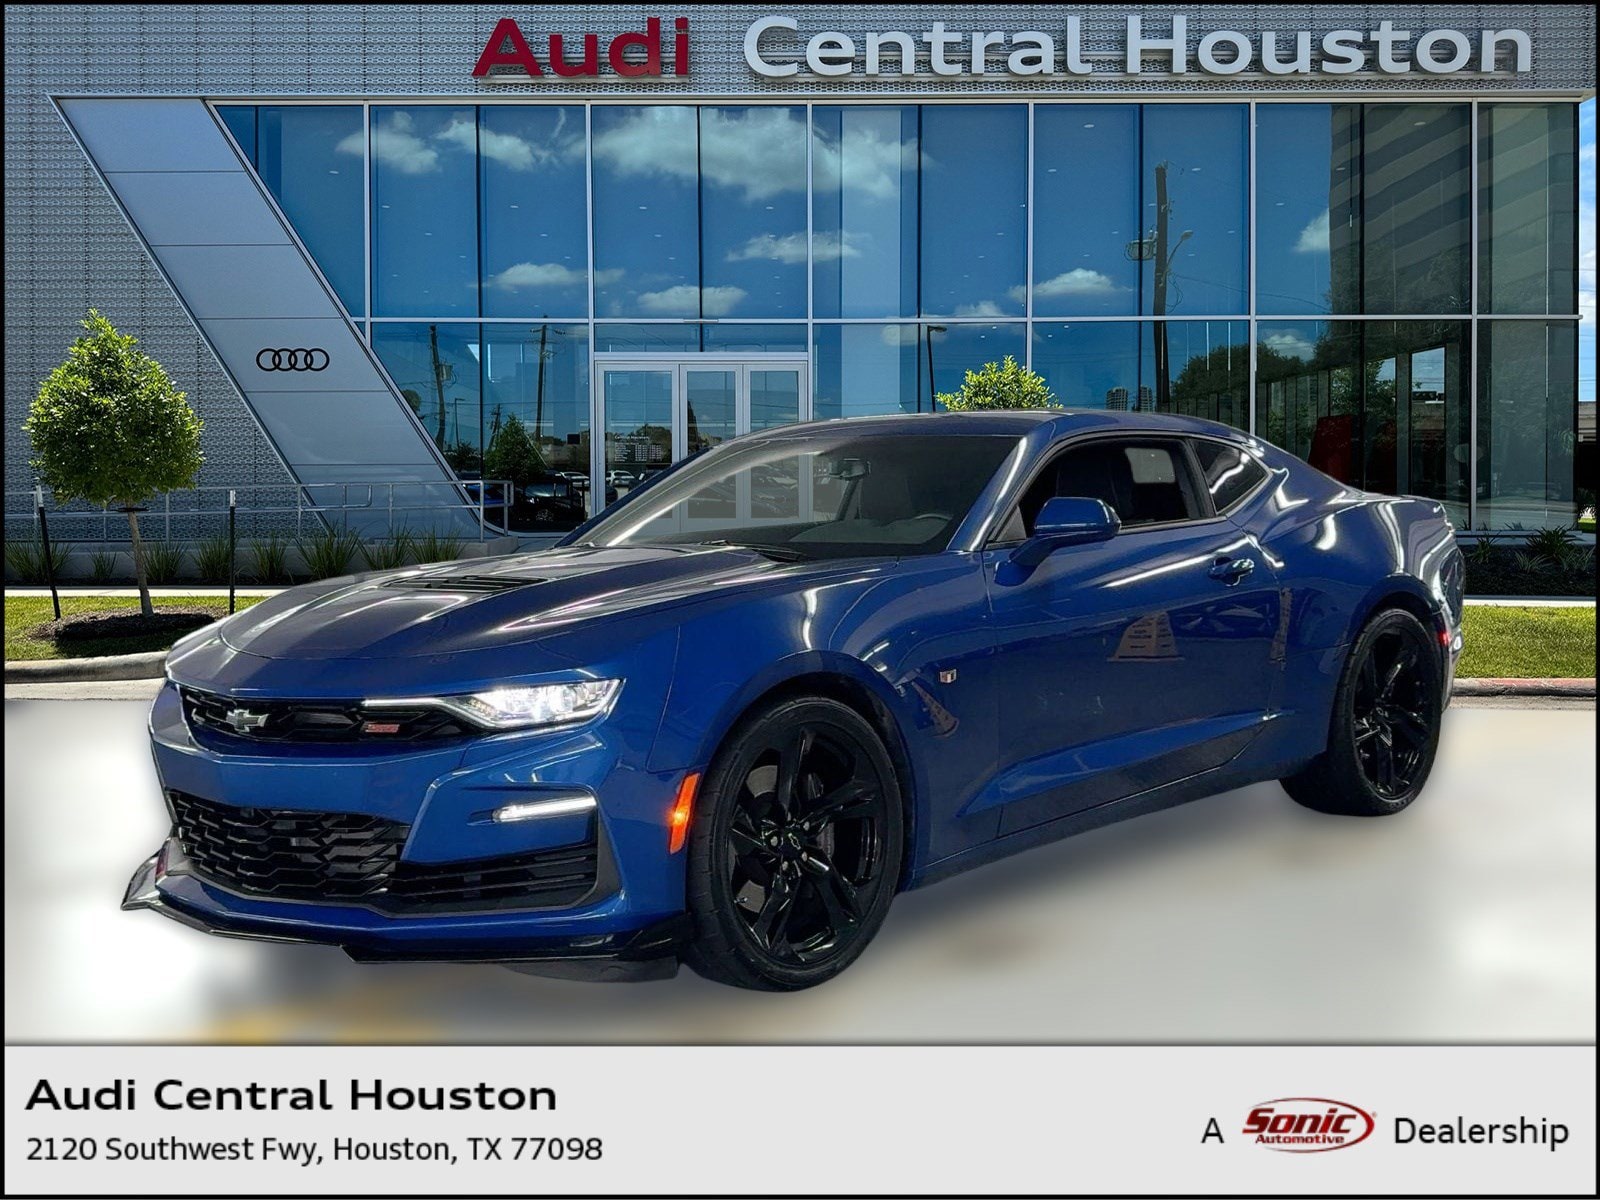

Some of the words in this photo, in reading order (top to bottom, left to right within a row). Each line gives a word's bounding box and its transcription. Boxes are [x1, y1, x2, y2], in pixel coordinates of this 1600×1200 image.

[472, 17, 689, 77] Audi
[743, 15, 1092, 77] Central
[1127, 15, 1532, 75] Houston
